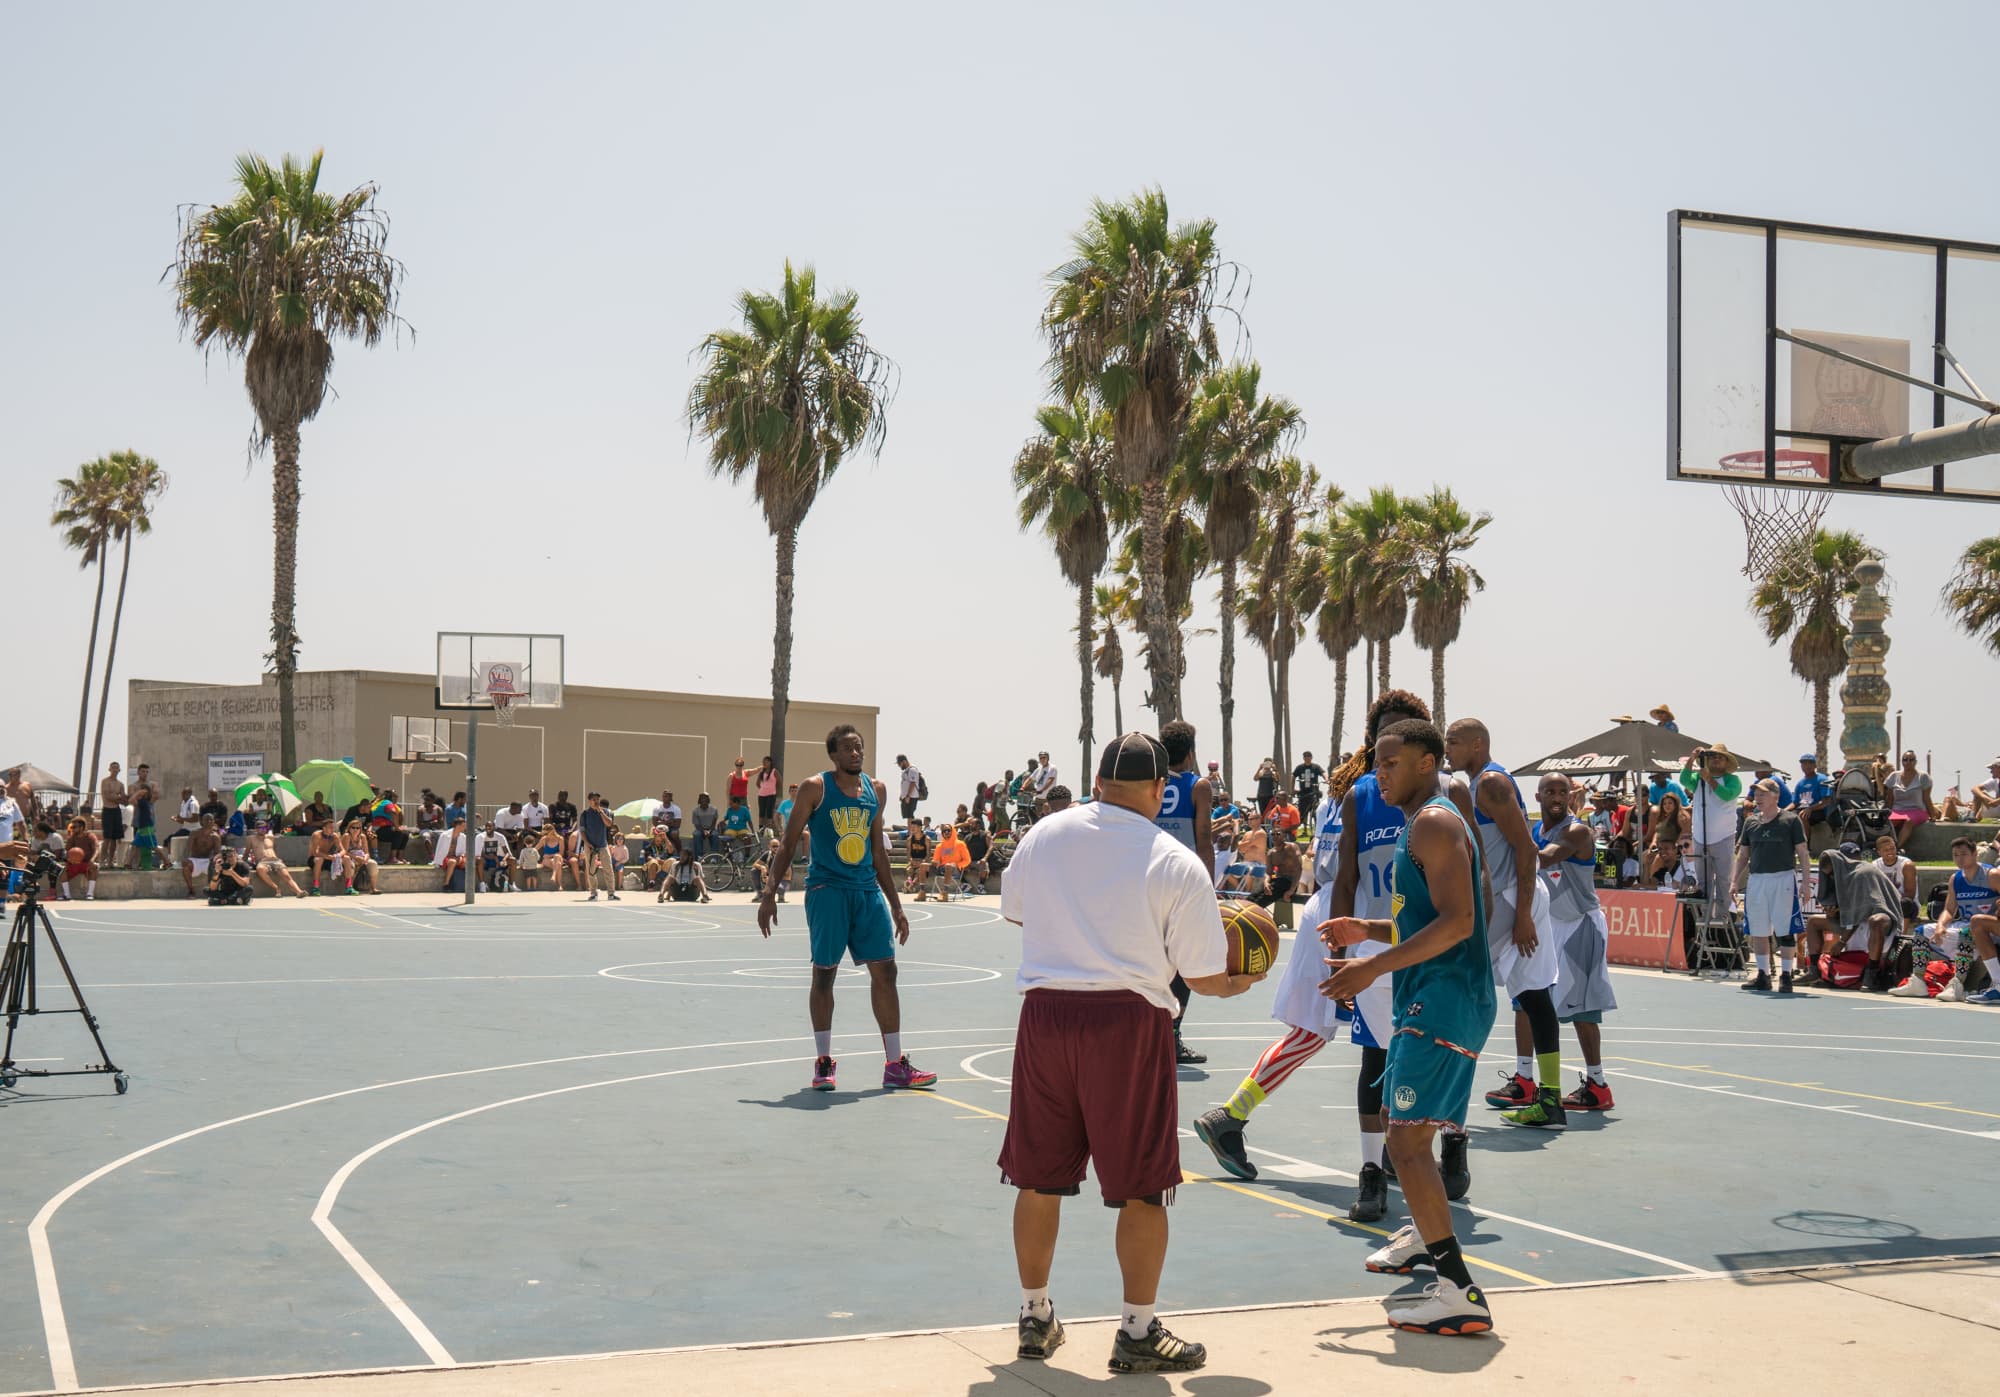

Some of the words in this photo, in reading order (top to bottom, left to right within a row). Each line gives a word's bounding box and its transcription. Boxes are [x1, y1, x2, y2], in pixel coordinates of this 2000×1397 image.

[145, 702, 180, 717] VENICE
[184, 699, 218, 716] BEACH
[221, 696, 282, 714] RECREATIO
[168, 723, 209, 735] DEPARTMENT
[213, 722, 222, 733] OF
[223, 721, 265, 733] RECREATION
[193, 741, 209, 753] CITY
[225, 740, 242, 752] LOS
[244, 739, 280, 752] ANGELES
[1537, 757, 1592, 771] MUSCLE
[1586, 755, 1625, 768] MILK
